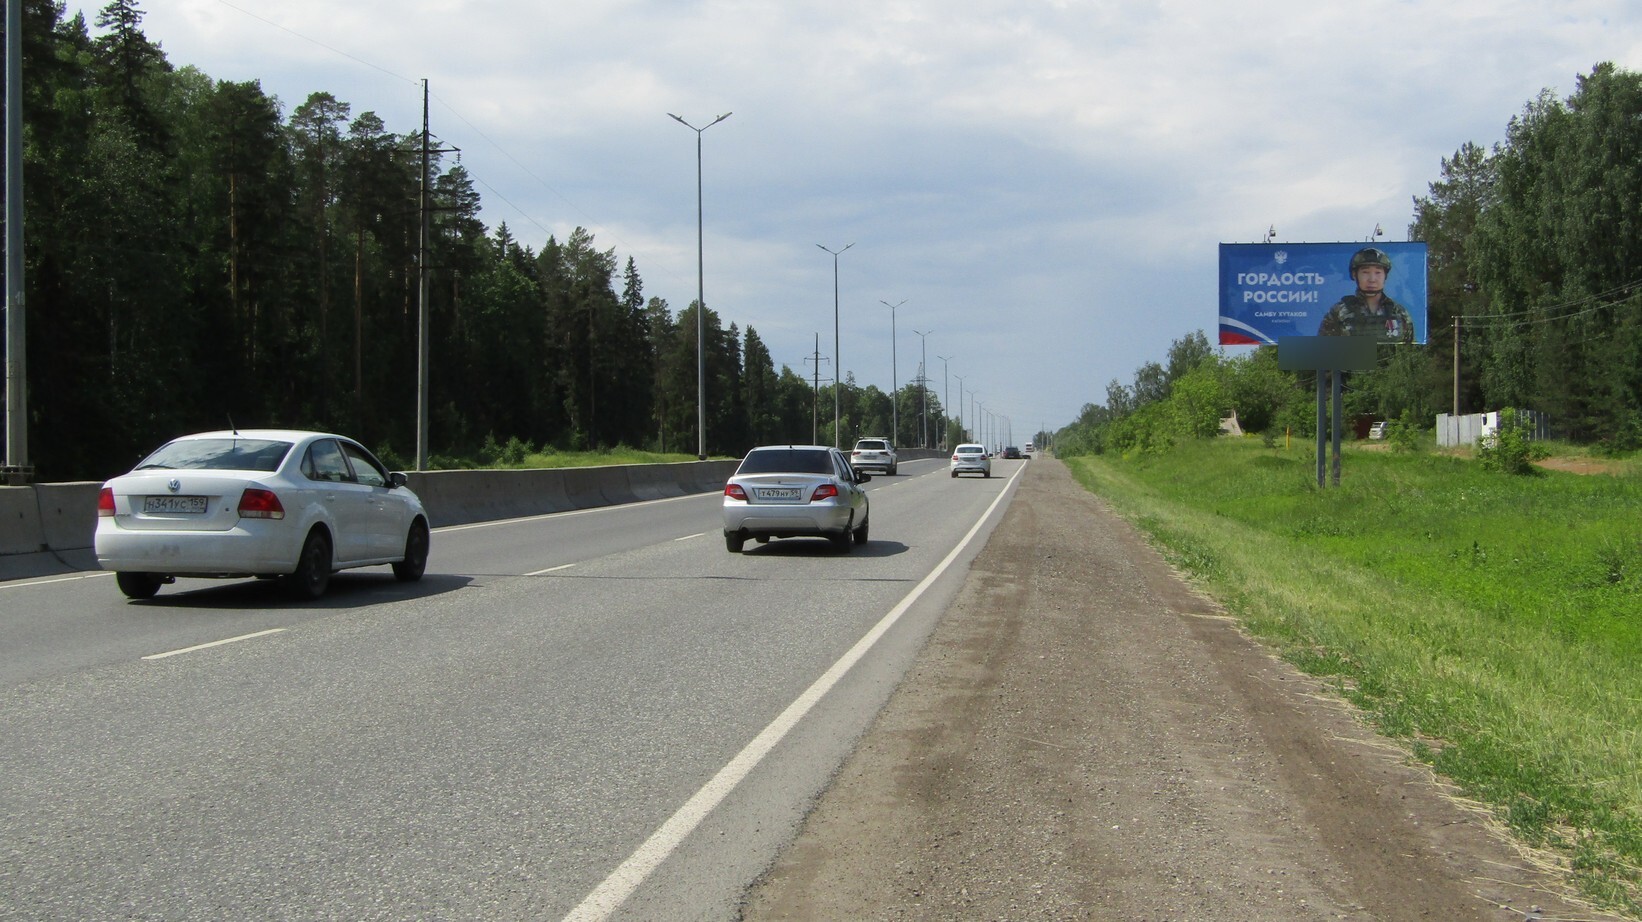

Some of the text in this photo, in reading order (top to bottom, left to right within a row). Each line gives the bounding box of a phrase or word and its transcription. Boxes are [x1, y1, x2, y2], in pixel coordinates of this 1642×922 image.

[1237, 272, 1325, 286] ГОРДОСТЬ
[1243, 290, 1318, 303] РОССИИ!
[148, 498, 204, 509] Н341УС 159
